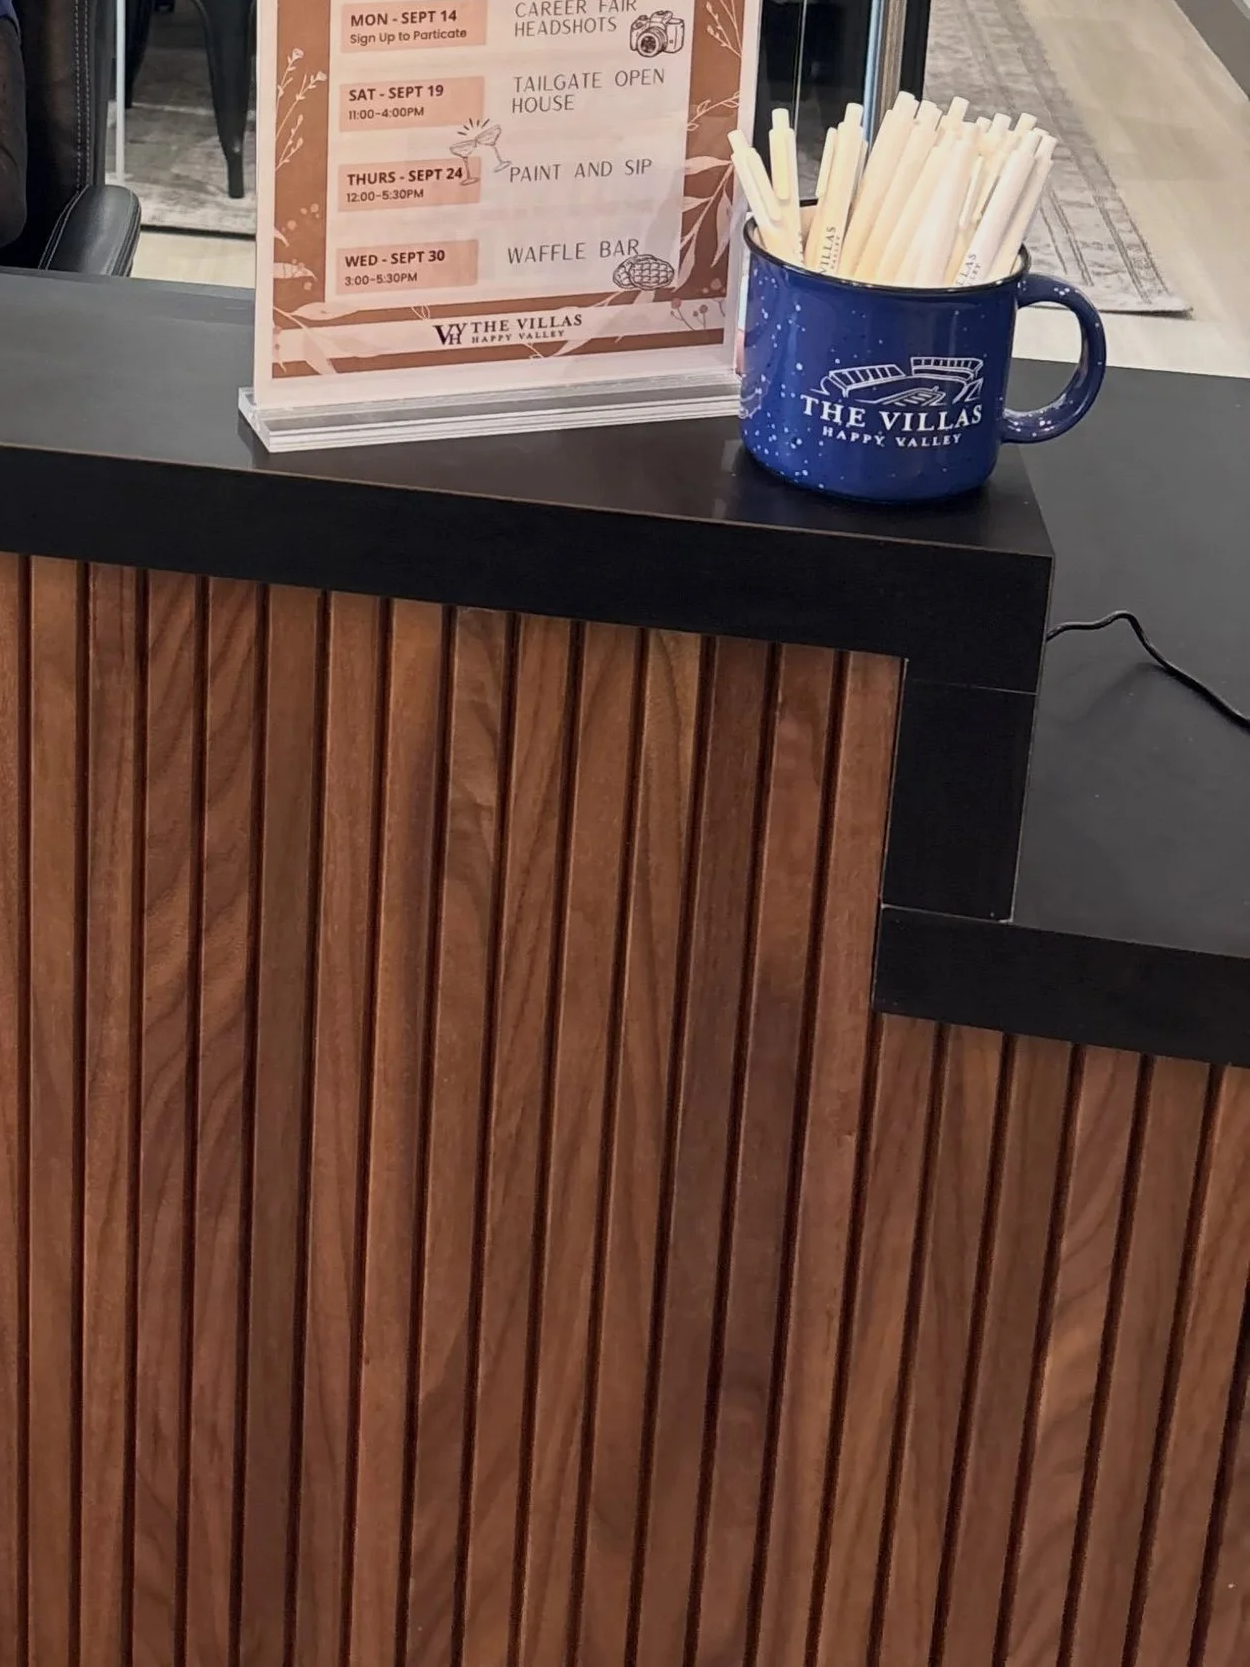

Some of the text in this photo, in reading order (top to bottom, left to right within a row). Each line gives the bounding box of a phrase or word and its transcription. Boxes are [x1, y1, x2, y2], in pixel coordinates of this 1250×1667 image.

[350, 13, 389, 27] MON
[400, 10, 437, 24] SEPT
[440, 9, 457, 22] 14
[515, 0, 587, 18] CAREER
[514, 16, 618, 37] HEADSHOTS
[349, 28, 467, 47] Sign Up to Particate
[513, 68, 665, 93] TAILGATE OPEN
[348, 88, 377, 102] SAT
[388, 85, 424, 99] SEPT
[428, 84, 445, 97] 19
[512, 94, 575, 114] HOUSE
[346, 171, 397, 186] THURS
[407, 168, 443, 182] SEPT
[446, 167, 464, 180] 24
[509, 158, 653, 183] PAINT AND SIP
[344, 253, 379, 268] WED
[390, 251, 425, 265] SEPT
[427, 249, 446, 263] 30
[507, 239, 640, 265] WAFFLE BAR
[819, 226, 836, 274] VILLAS
[471, 319, 510, 334] THE
[517, 314, 583, 331] VILLAS
[471, 330, 565, 344] HAPPY VALLEY
[800, 394, 982, 432] THE VILLAS
[822, 425, 962, 448] HAPPY VALLEY
